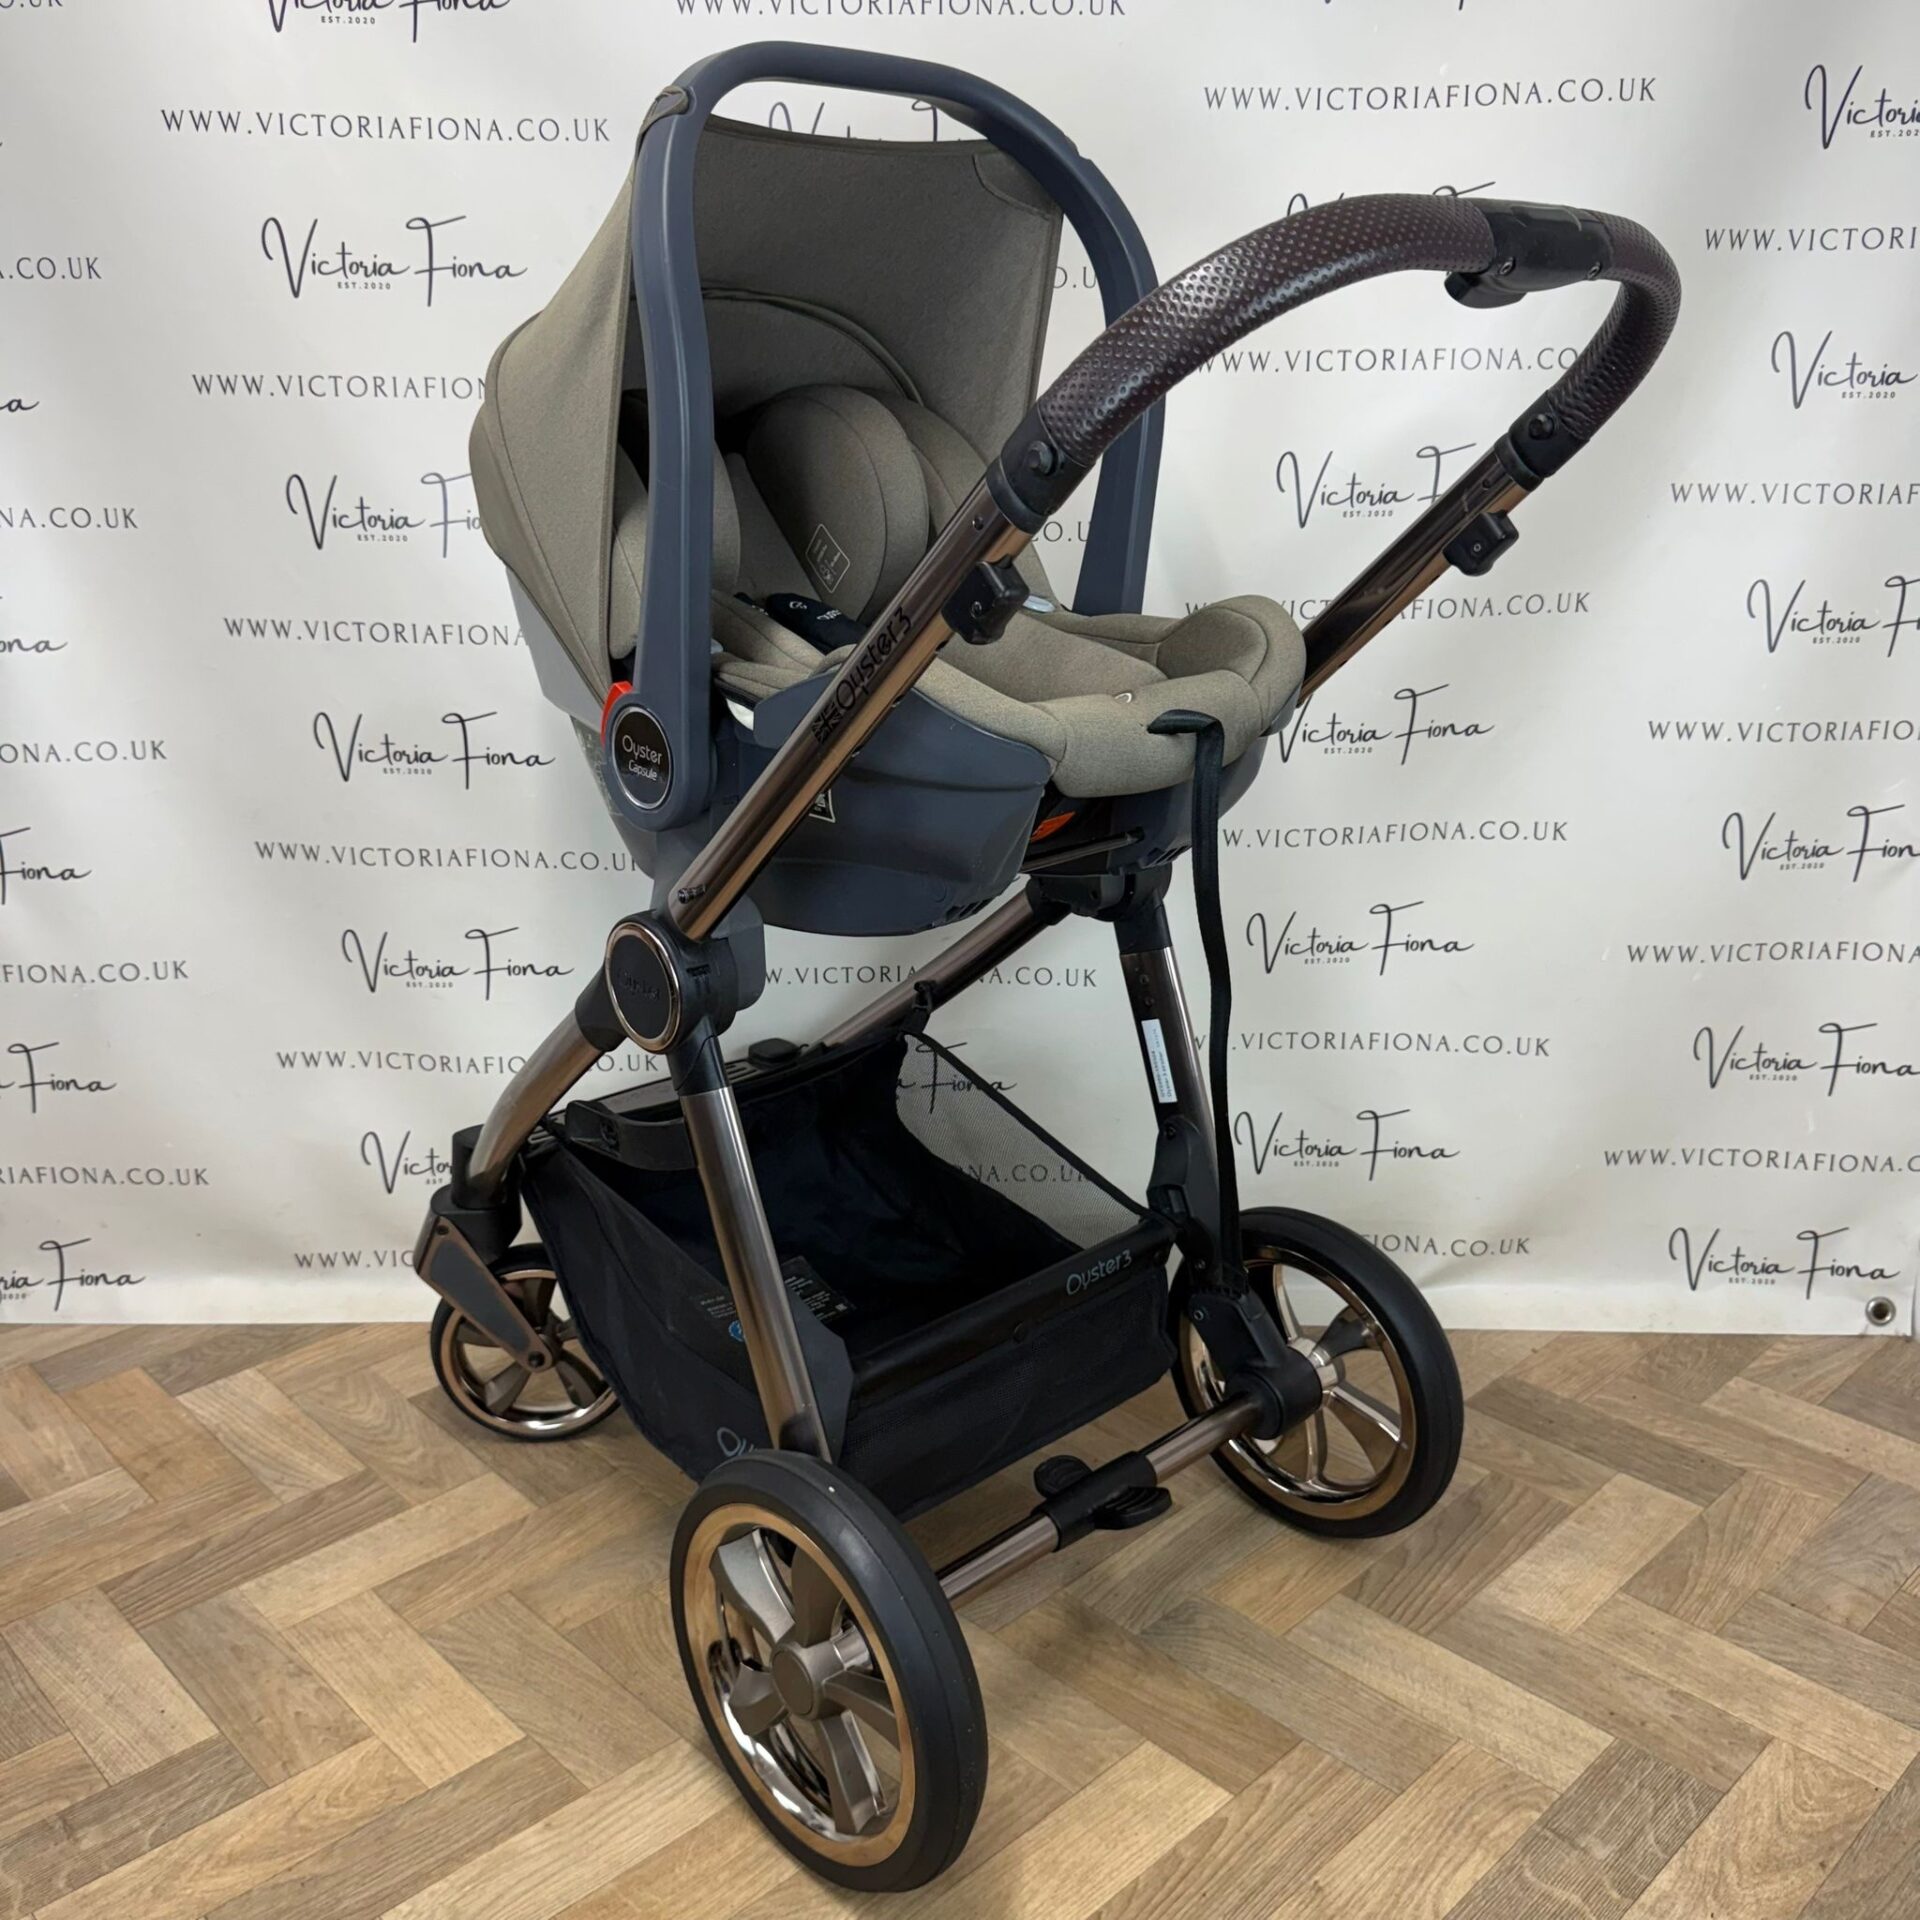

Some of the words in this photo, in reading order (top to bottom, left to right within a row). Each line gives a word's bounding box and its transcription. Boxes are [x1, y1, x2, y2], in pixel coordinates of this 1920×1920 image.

[321, 16, 376, 25] EST.2020
[1204, 77, 1657, 112] WWW.VICTORIAFIONA.CO.UK
[1805, 64, 1920, 149] Victori
[160, 109, 611, 143] WWW.VICTORIAFIONA.CO.UK
[261, 217, 410, 298] Victoria
[406, 215, 528, 307] Fiona
[337, 281, 392, 291] EST.2020
[1771, 330, 1919, 410] Victoria
[1841, 391, 1896, 400] EST.2020
[286, 474, 425, 550] Victoria
[1276, 451, 1414, 529] Victoria
[1342, 510, 1394, 518] EST.2020
[357, 534, 408, 542] EST.2020
[1747, 579, 1880, 653] Victoria
[1812, 636, 1861, 644] EST.2020
[313, 712, 449, 782] Victoria
[442, 711, 556, 790] Fiona
[622, 735, 662, 765] Oyster
[1324, 747, 1374, 755] EST.2020
[1394, 684, 1495, 765] Fiona
[1648, 720, 1920, 744] WWW.VICTORIAFIO
[383, 767, 432, 775] EST.2020
[628, 760, 657, 781] Capsule
[1722, 812, 1845, 881] Victoria
[1779, 862, 1825, 870] EST.2020
[341, 929, 470, 993] Victoria
[465, 927, 575, 1001] Fiona
[1246, 911, 1369, 974] Victoria
[1369, 901, 1475, 976] Fiona
[1304, 957, 1351, 965] EST.2020
[8, 1042, 117, 1113] Fiona
[1693, 1025, 1818, 1089] Victoria
[1818, 1022, 1920, 1096] Fiona
[1234, 1112, 1357, 1175] Victoria
[1356, 1109, 1460, 1181] Fiona
[39, 1237, 146, 1312] Fiona
[1066, 1249, 1133, 1296] Oyster3
[1668, 1227, 1795, 1291] Victoria
[1796, 1227, 1900, 1300] Fiona
